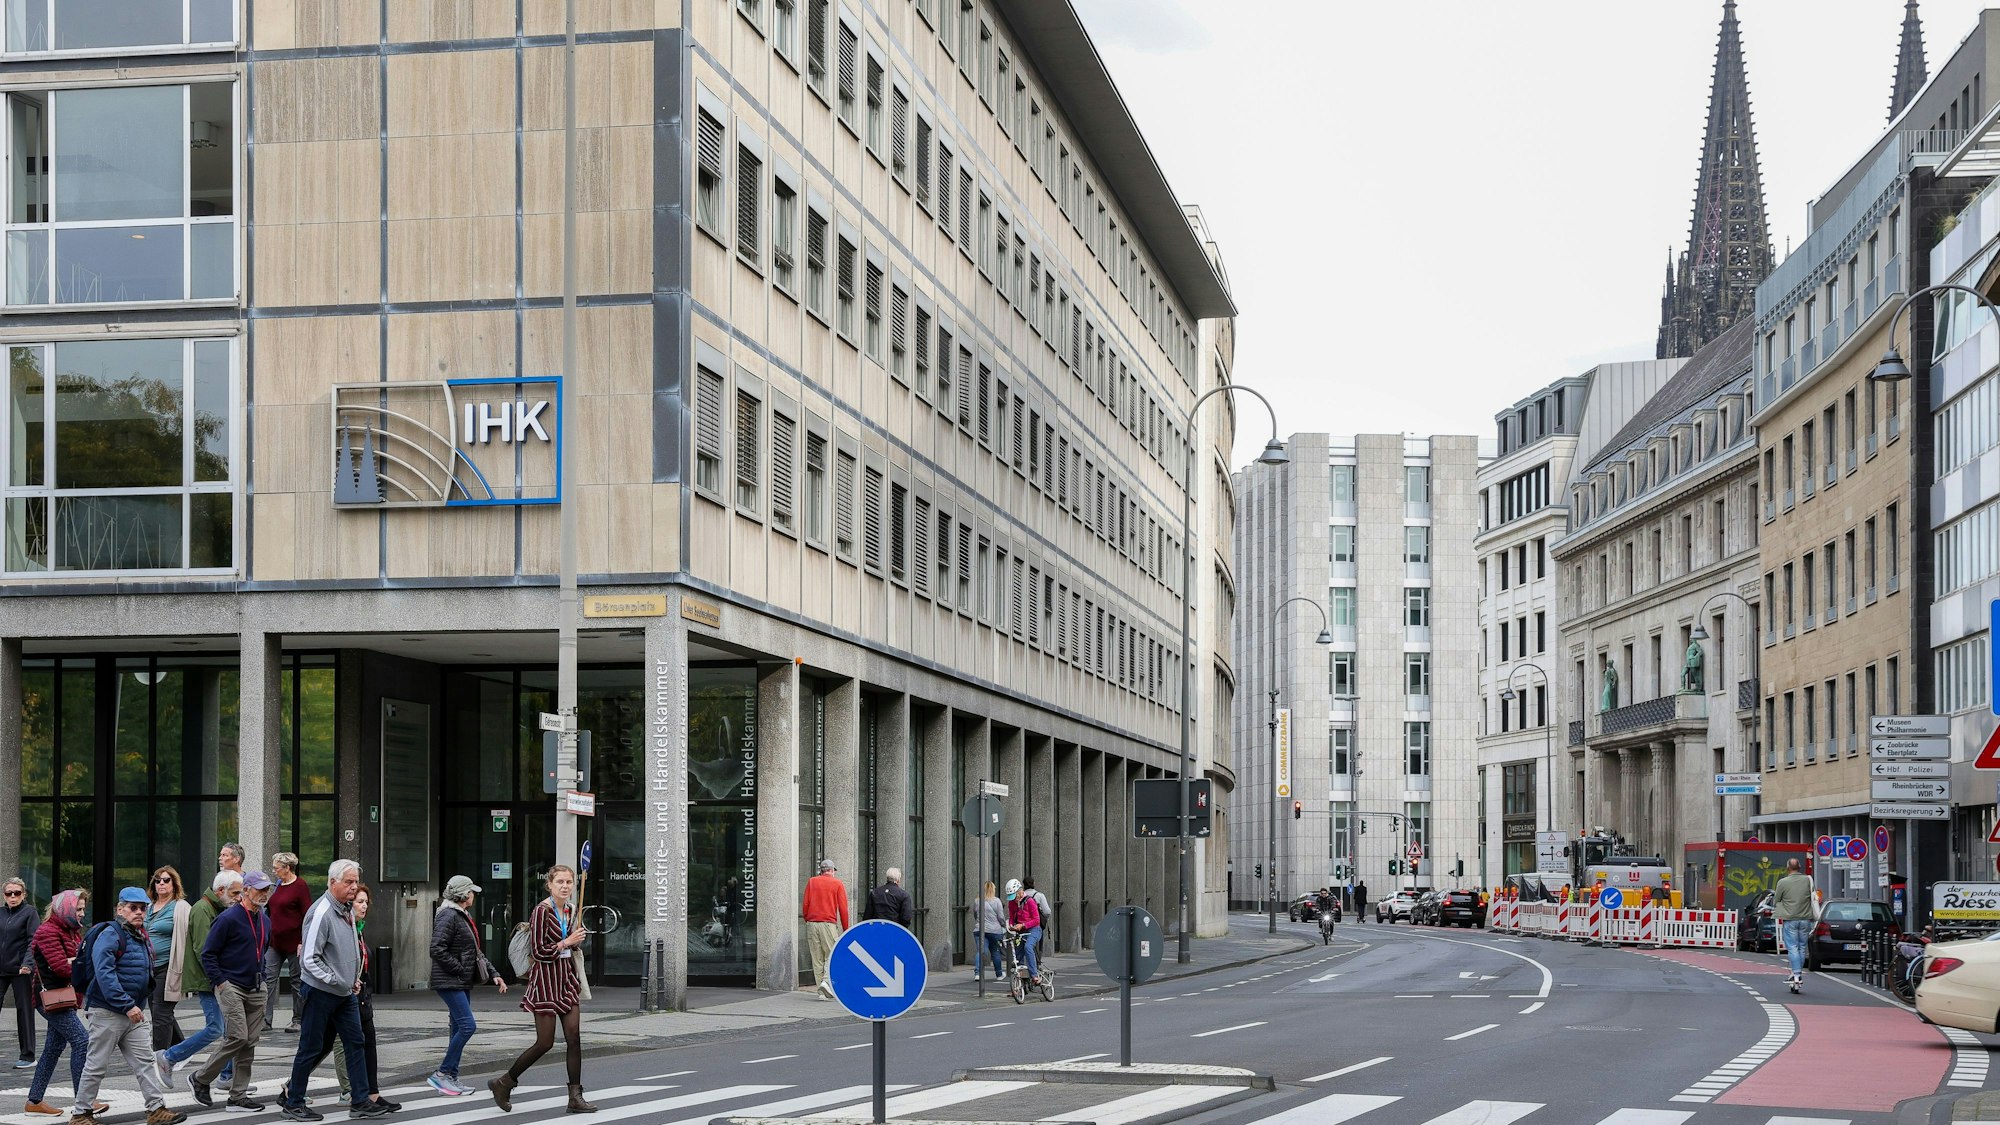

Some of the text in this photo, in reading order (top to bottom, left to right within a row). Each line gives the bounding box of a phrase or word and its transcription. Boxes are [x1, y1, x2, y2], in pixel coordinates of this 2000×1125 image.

[464, 400, 550, 443] IHK
[653, 658, 668, 792] Handelskammer
[741, 684, 754, 797] Handelskammer
[1280, 712, 1288, 780] COMMERZBANK
[1887, 749, 1918, 757] Ebertplatz
[653, 801, 668, 833] und
[741, 808, 754, 836] und
[1874, 807, 1933, 816] Bezirksregierung
[1943, 893, 1997, 909] Riese
[1947, 885, 1964, 893] der
